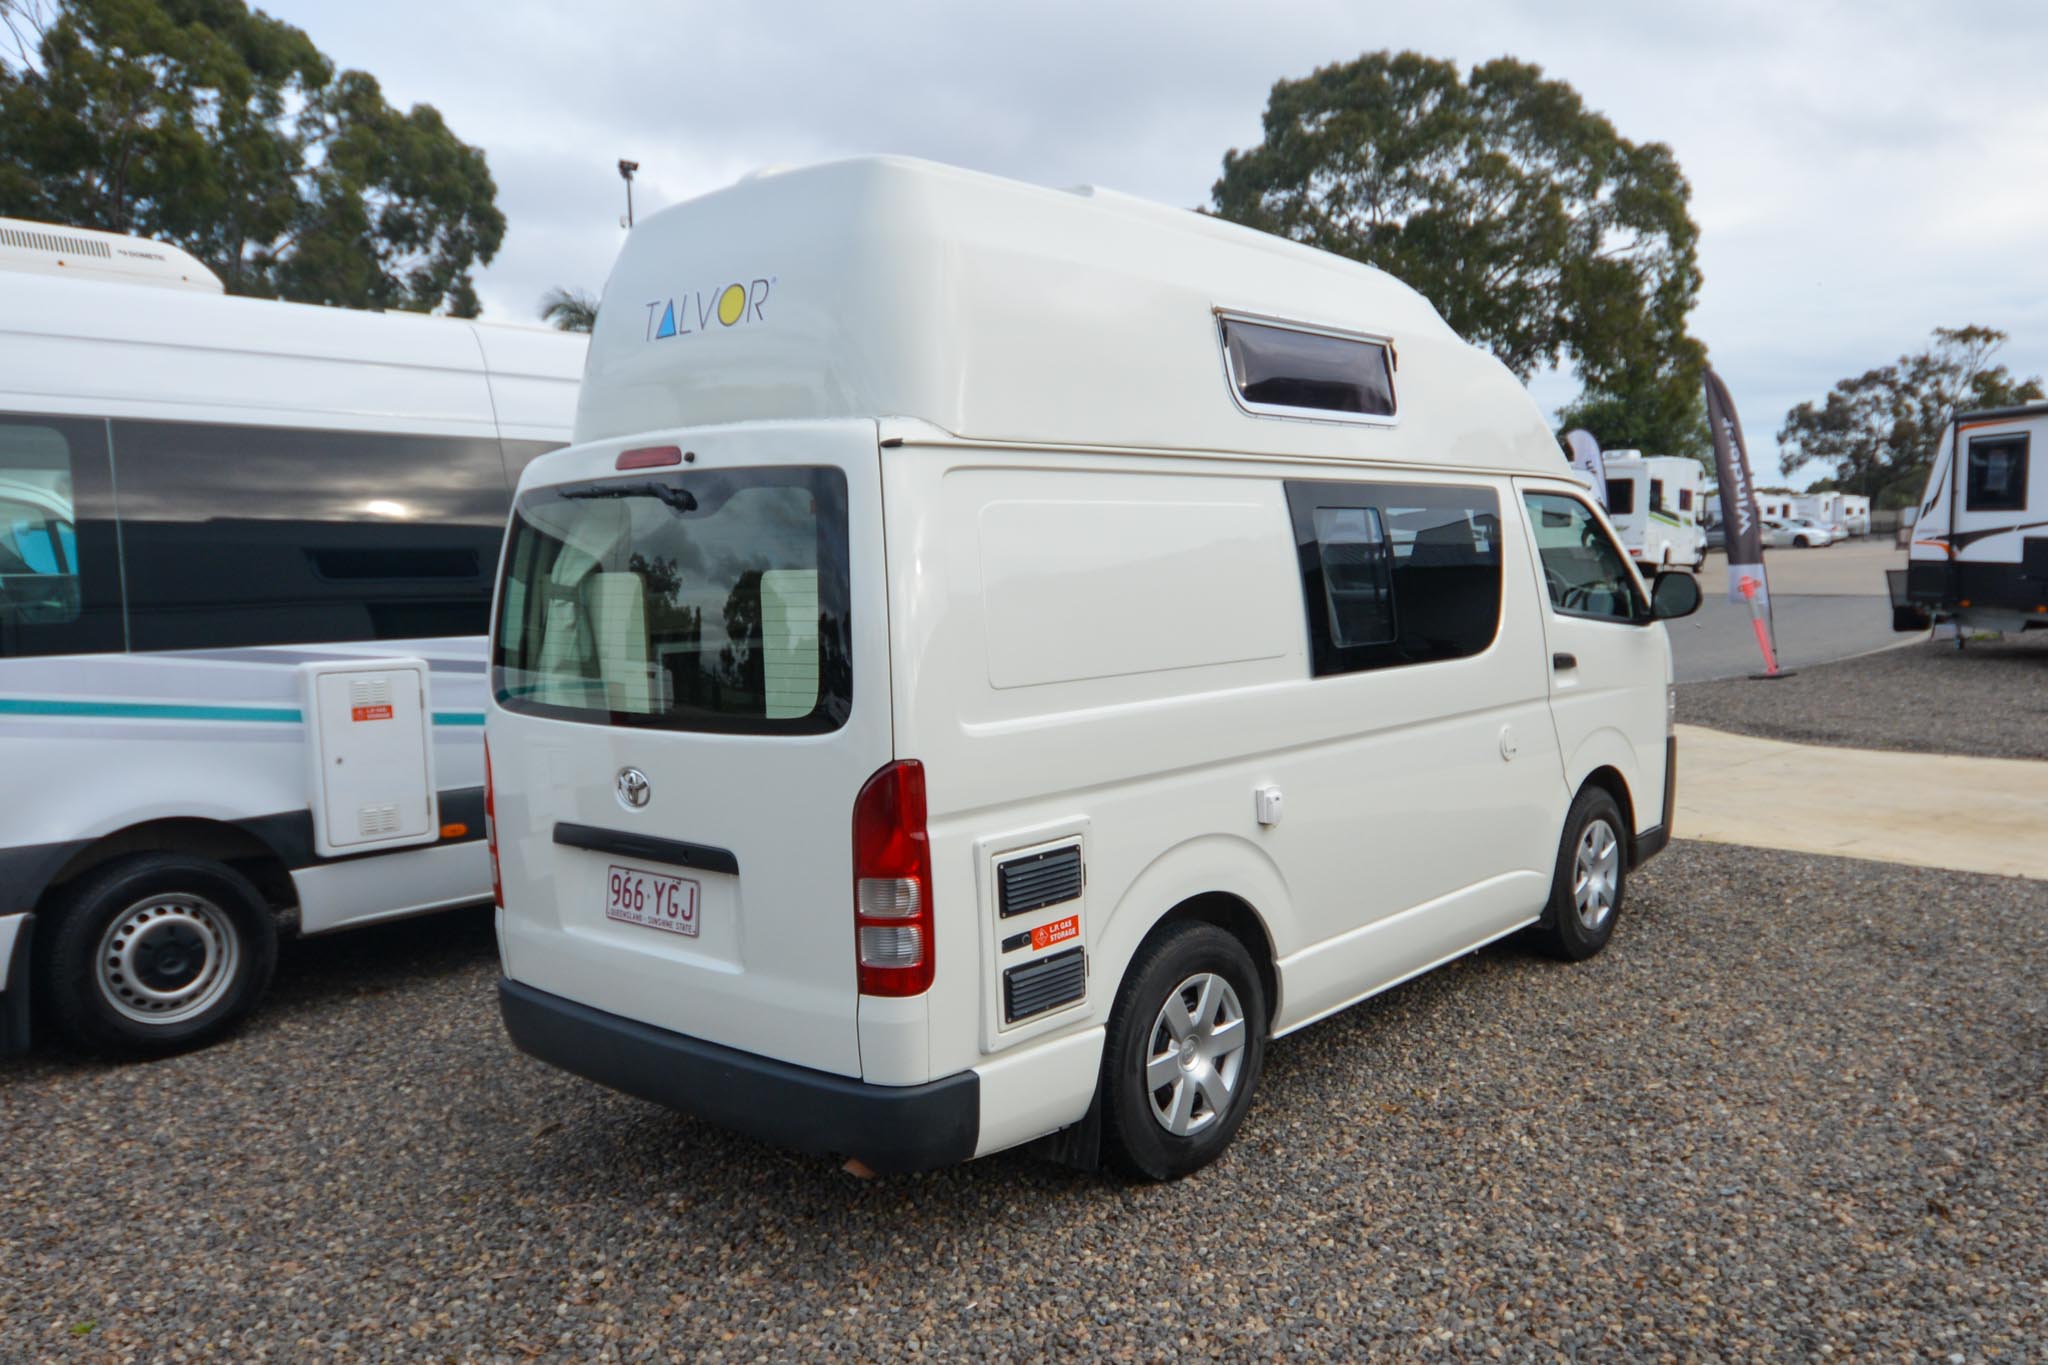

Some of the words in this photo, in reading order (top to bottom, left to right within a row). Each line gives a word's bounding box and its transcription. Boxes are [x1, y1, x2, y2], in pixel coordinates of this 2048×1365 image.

[646, 279, 769, 341] TALVOR
[675, 922, 693, 934] STATE
[1060, 920, 1073, 929] GAS
[1050, 928, 1077, 942] STORAGE
